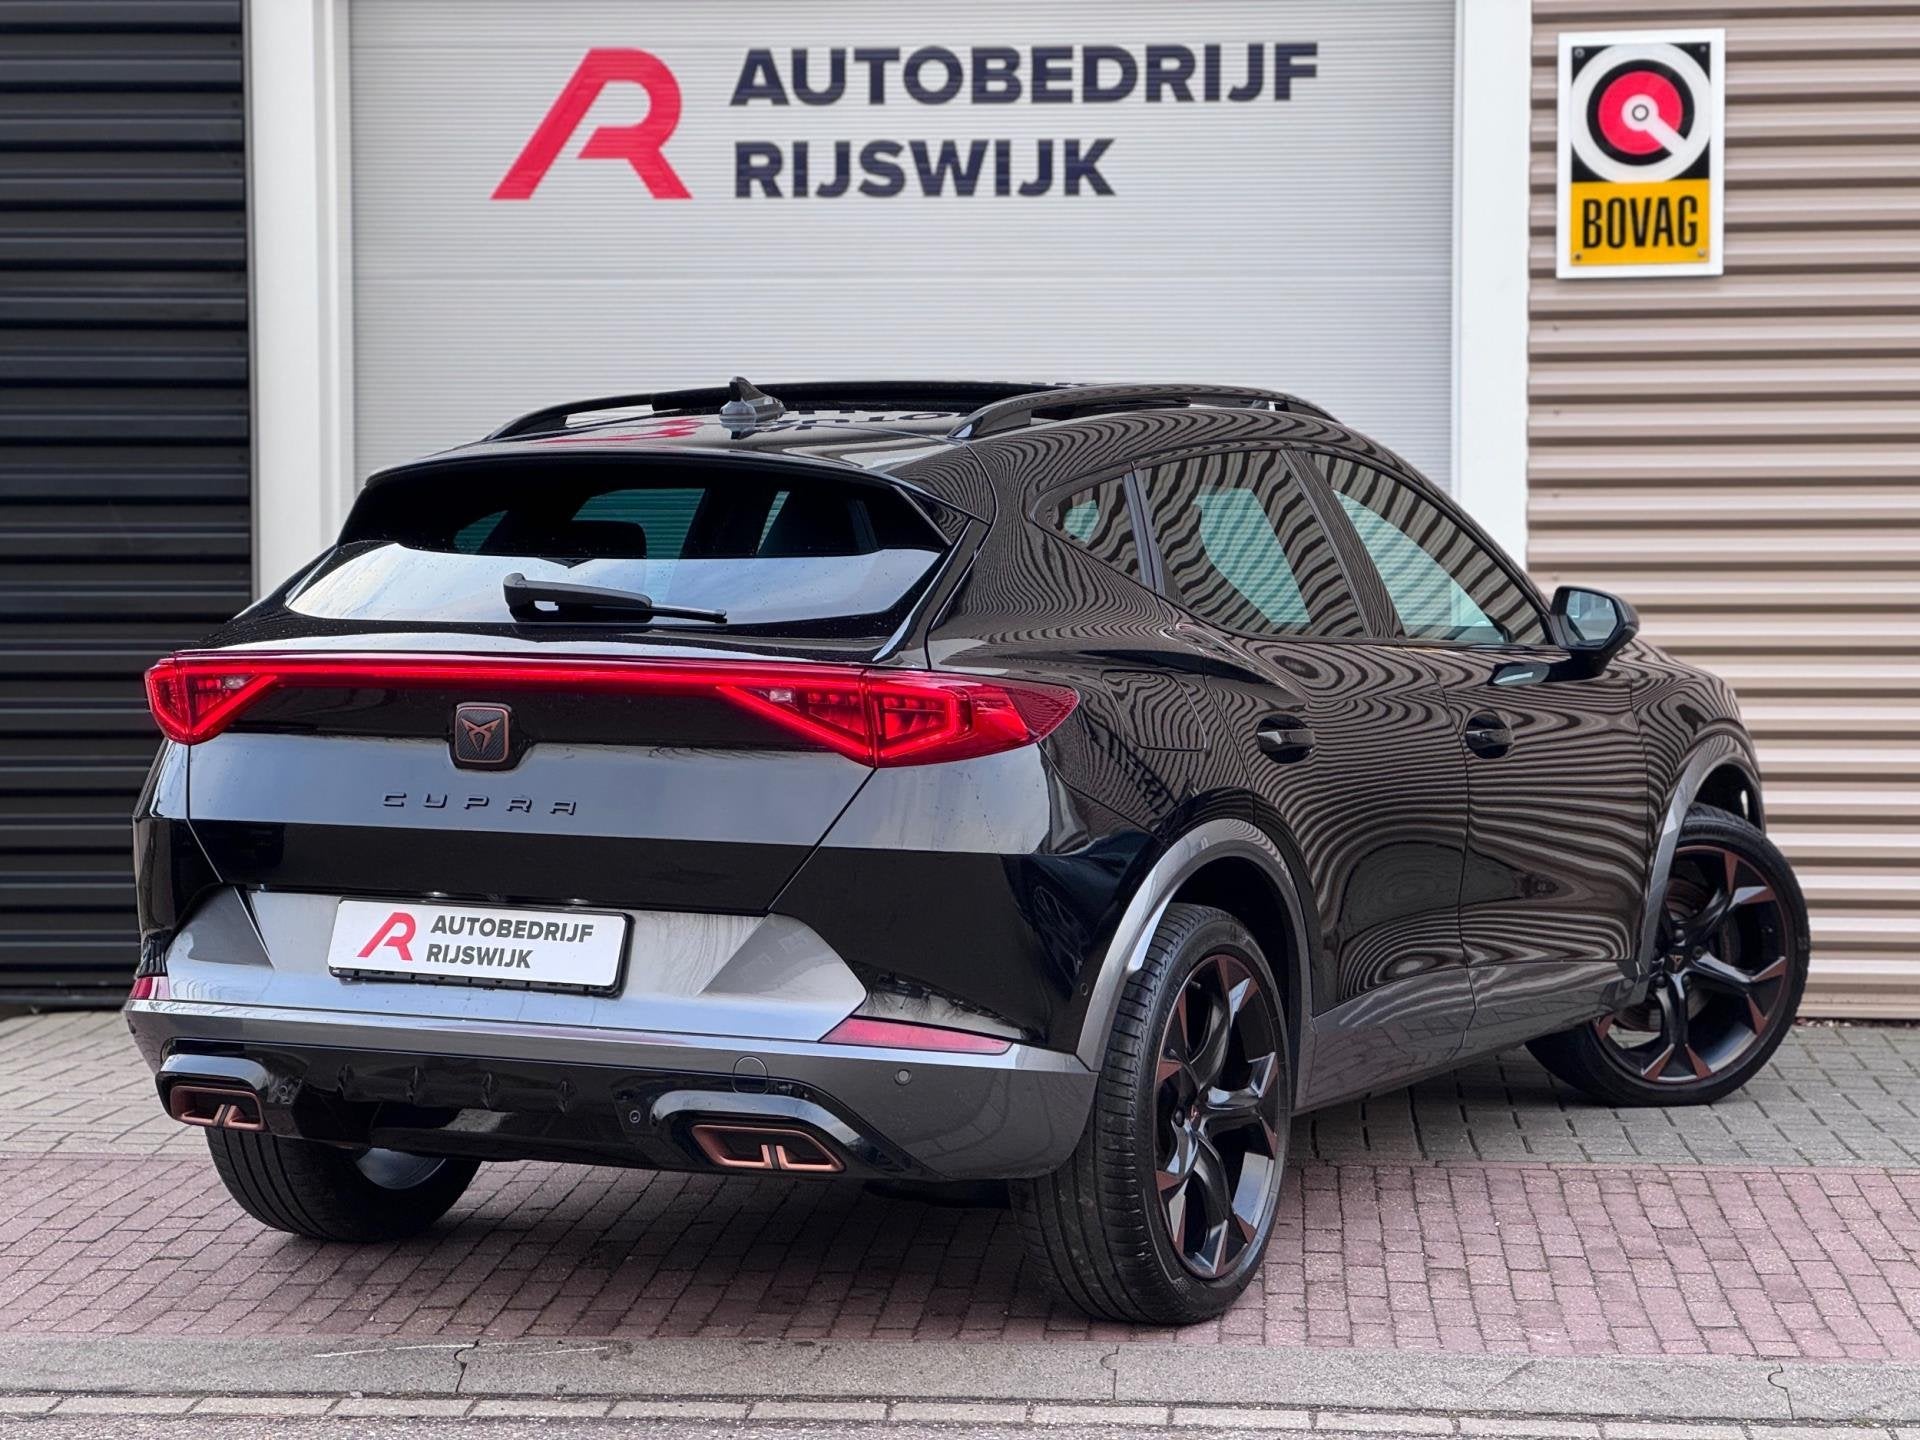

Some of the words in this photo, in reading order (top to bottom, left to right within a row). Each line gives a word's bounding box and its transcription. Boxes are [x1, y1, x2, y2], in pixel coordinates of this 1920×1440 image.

[730, 43, 1318, 107] AUTOBEDRIJF
[735, 138, 1116, 197] RIJSWIJK
[1583, 195, 1698, 249] BOVAG
[383, 792, 577, 816] CUPRA
[430, 915, 594, 943] AUTOBEDRIJF
[426, 943, 534, 969] RIJSWIJK
